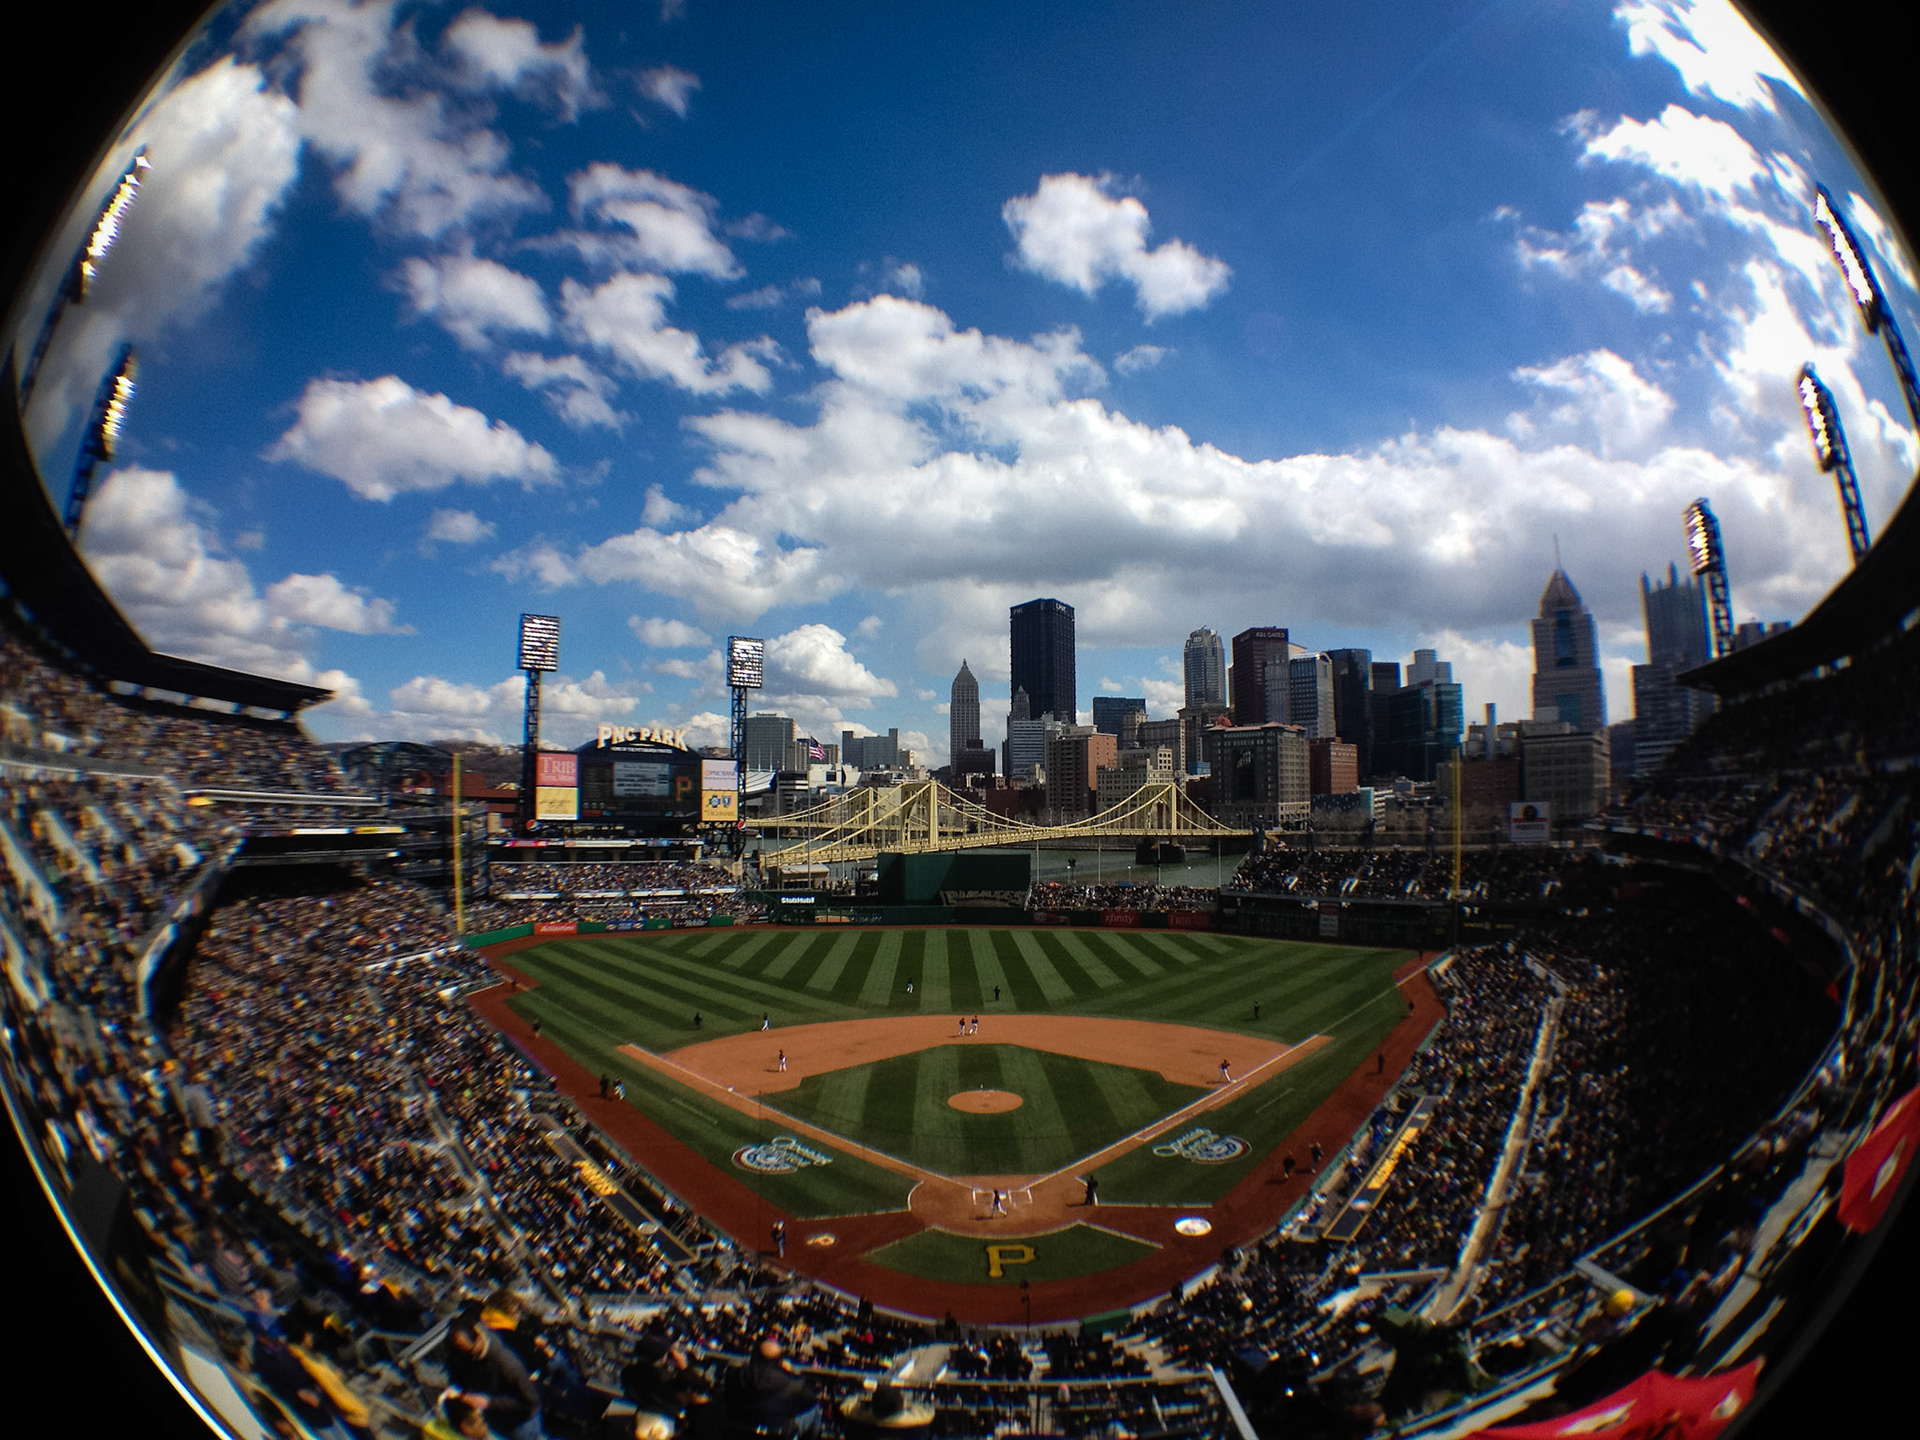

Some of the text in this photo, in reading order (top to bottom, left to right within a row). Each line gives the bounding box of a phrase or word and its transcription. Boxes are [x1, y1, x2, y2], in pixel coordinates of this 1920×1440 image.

[1267, 631, 1285, 639] GATES
[597, 725, 688, 752] PNC PARK
[540, 757, 574, 773] TRIB
[676, 777, 692, 801] P
[1105, 914, 1135, 923] xfinity
[986, 1245, 1035, 1278] P
